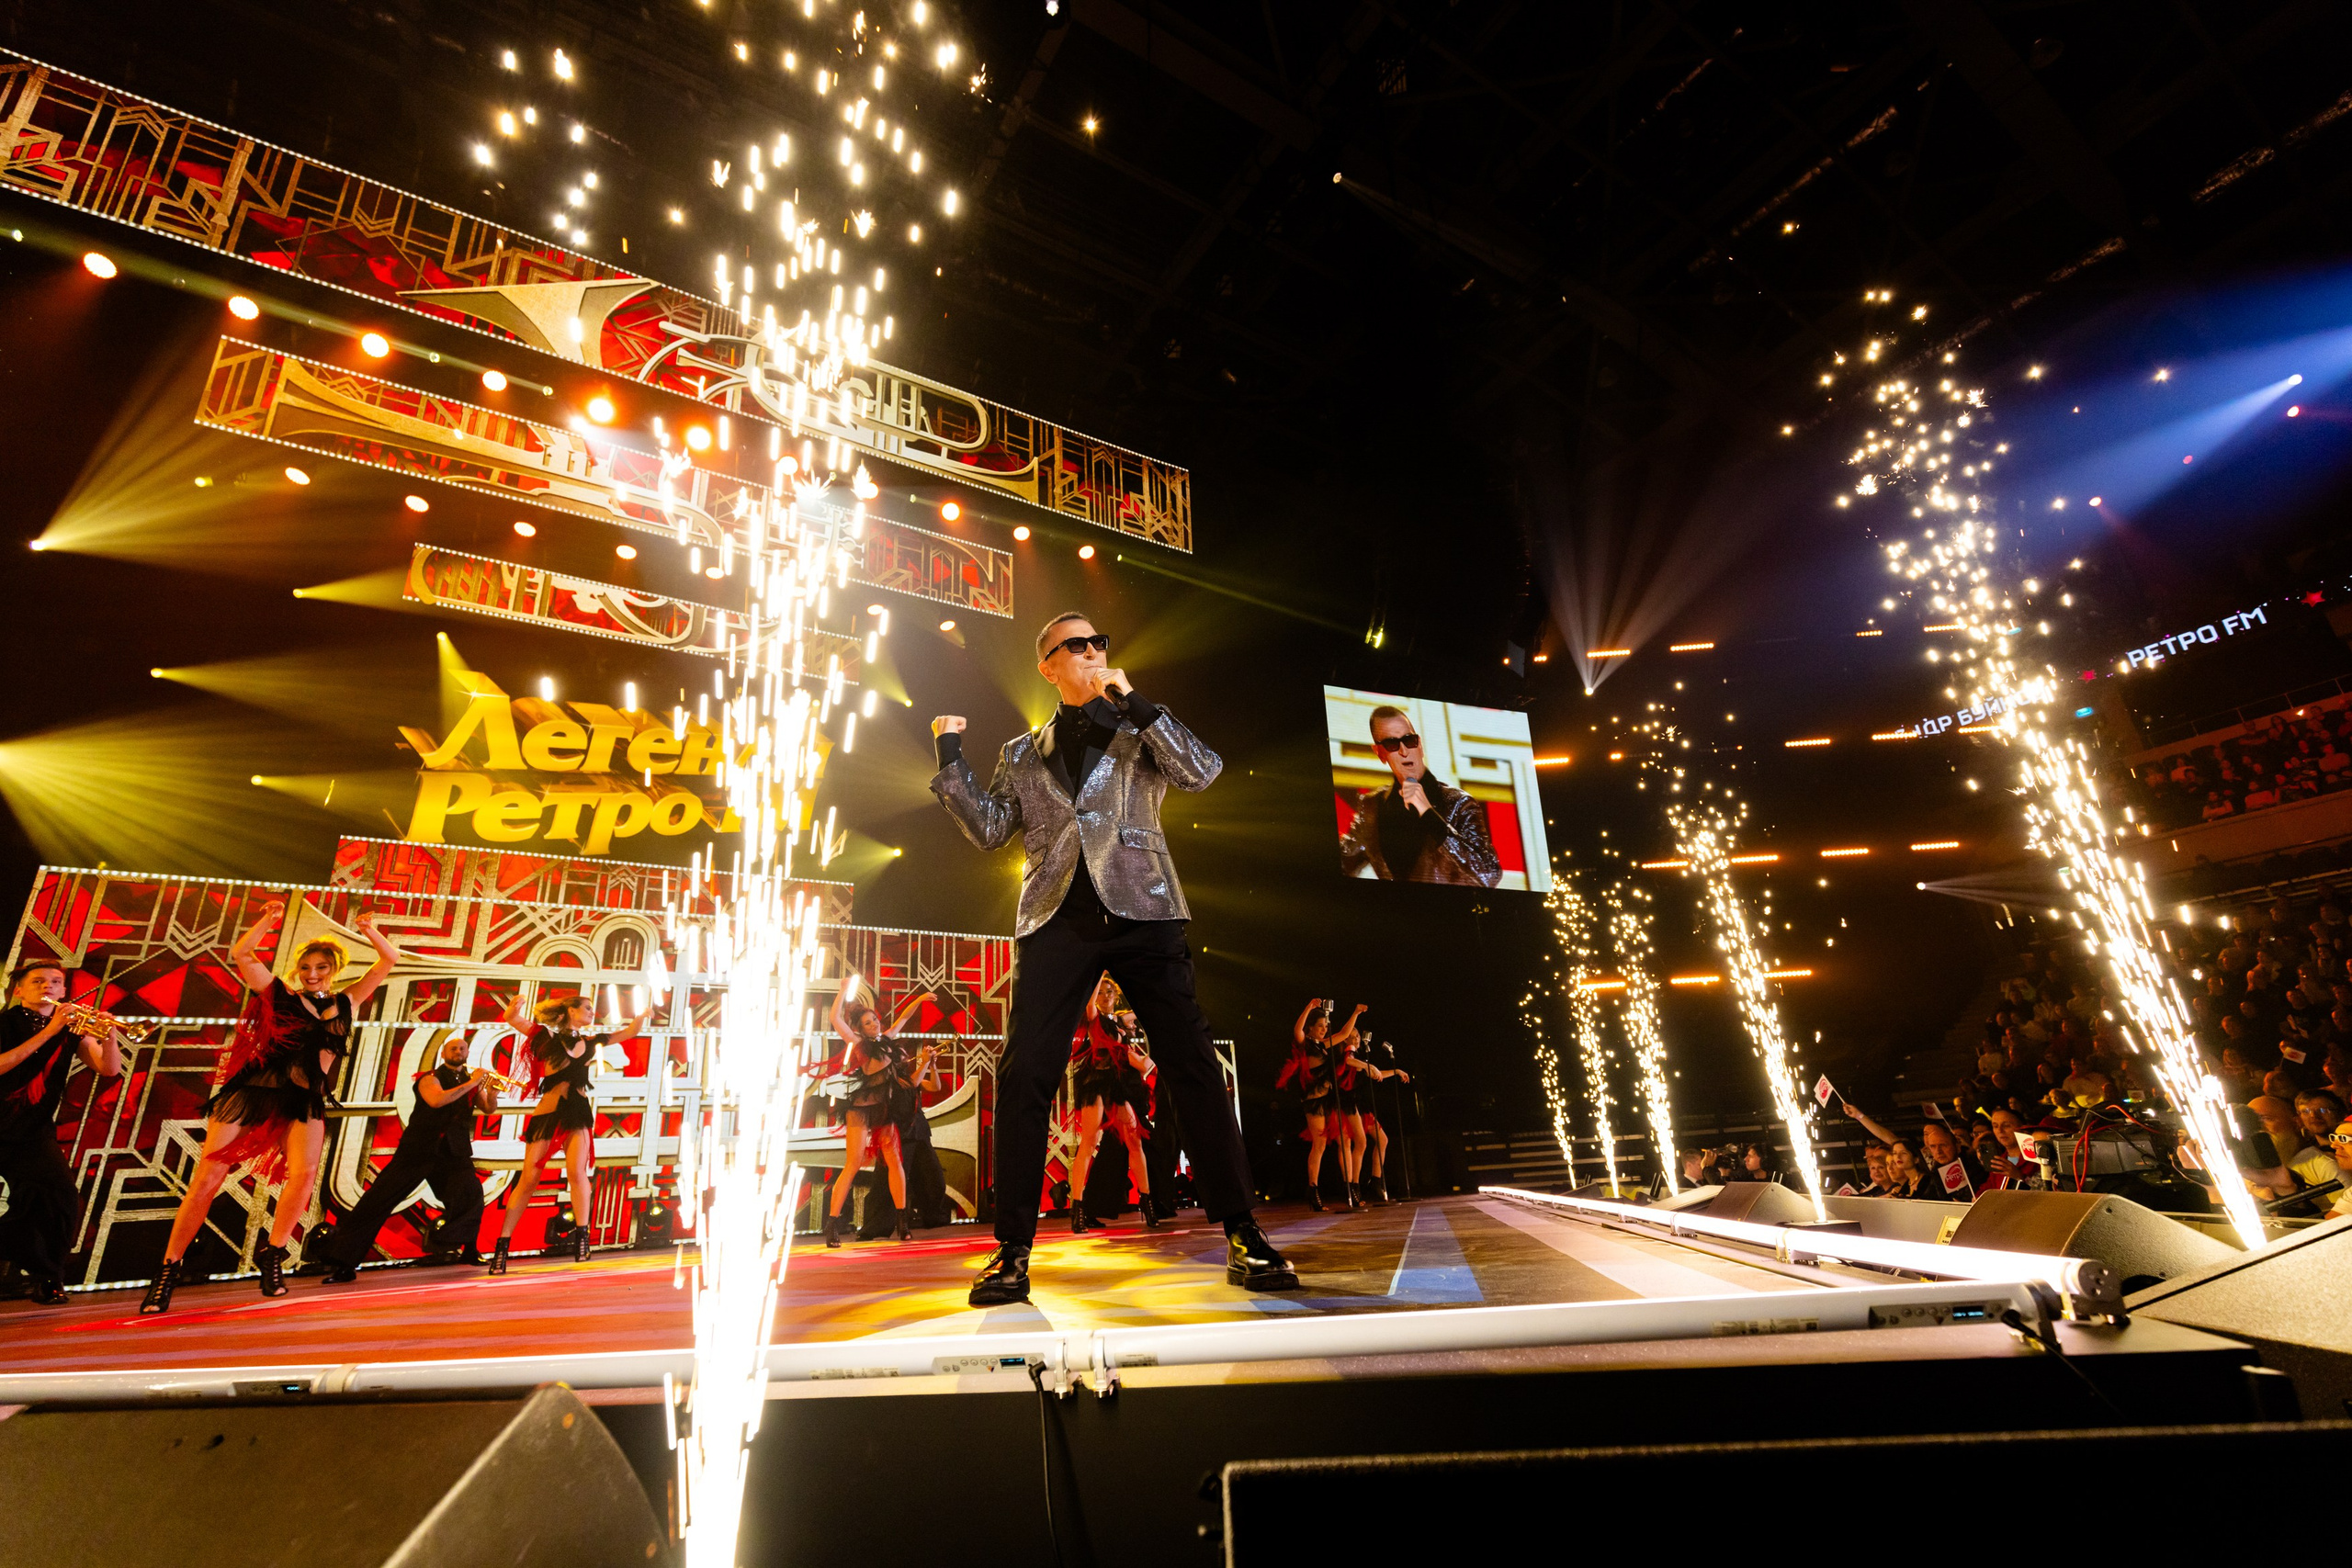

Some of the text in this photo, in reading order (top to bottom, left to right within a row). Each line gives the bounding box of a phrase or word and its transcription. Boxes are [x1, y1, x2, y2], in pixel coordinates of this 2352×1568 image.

[2127, 607, 2267, 668] РЕТРО FM
[398, 669, 834, 779] Леген
[405, 772, 704, 854] Ретро
